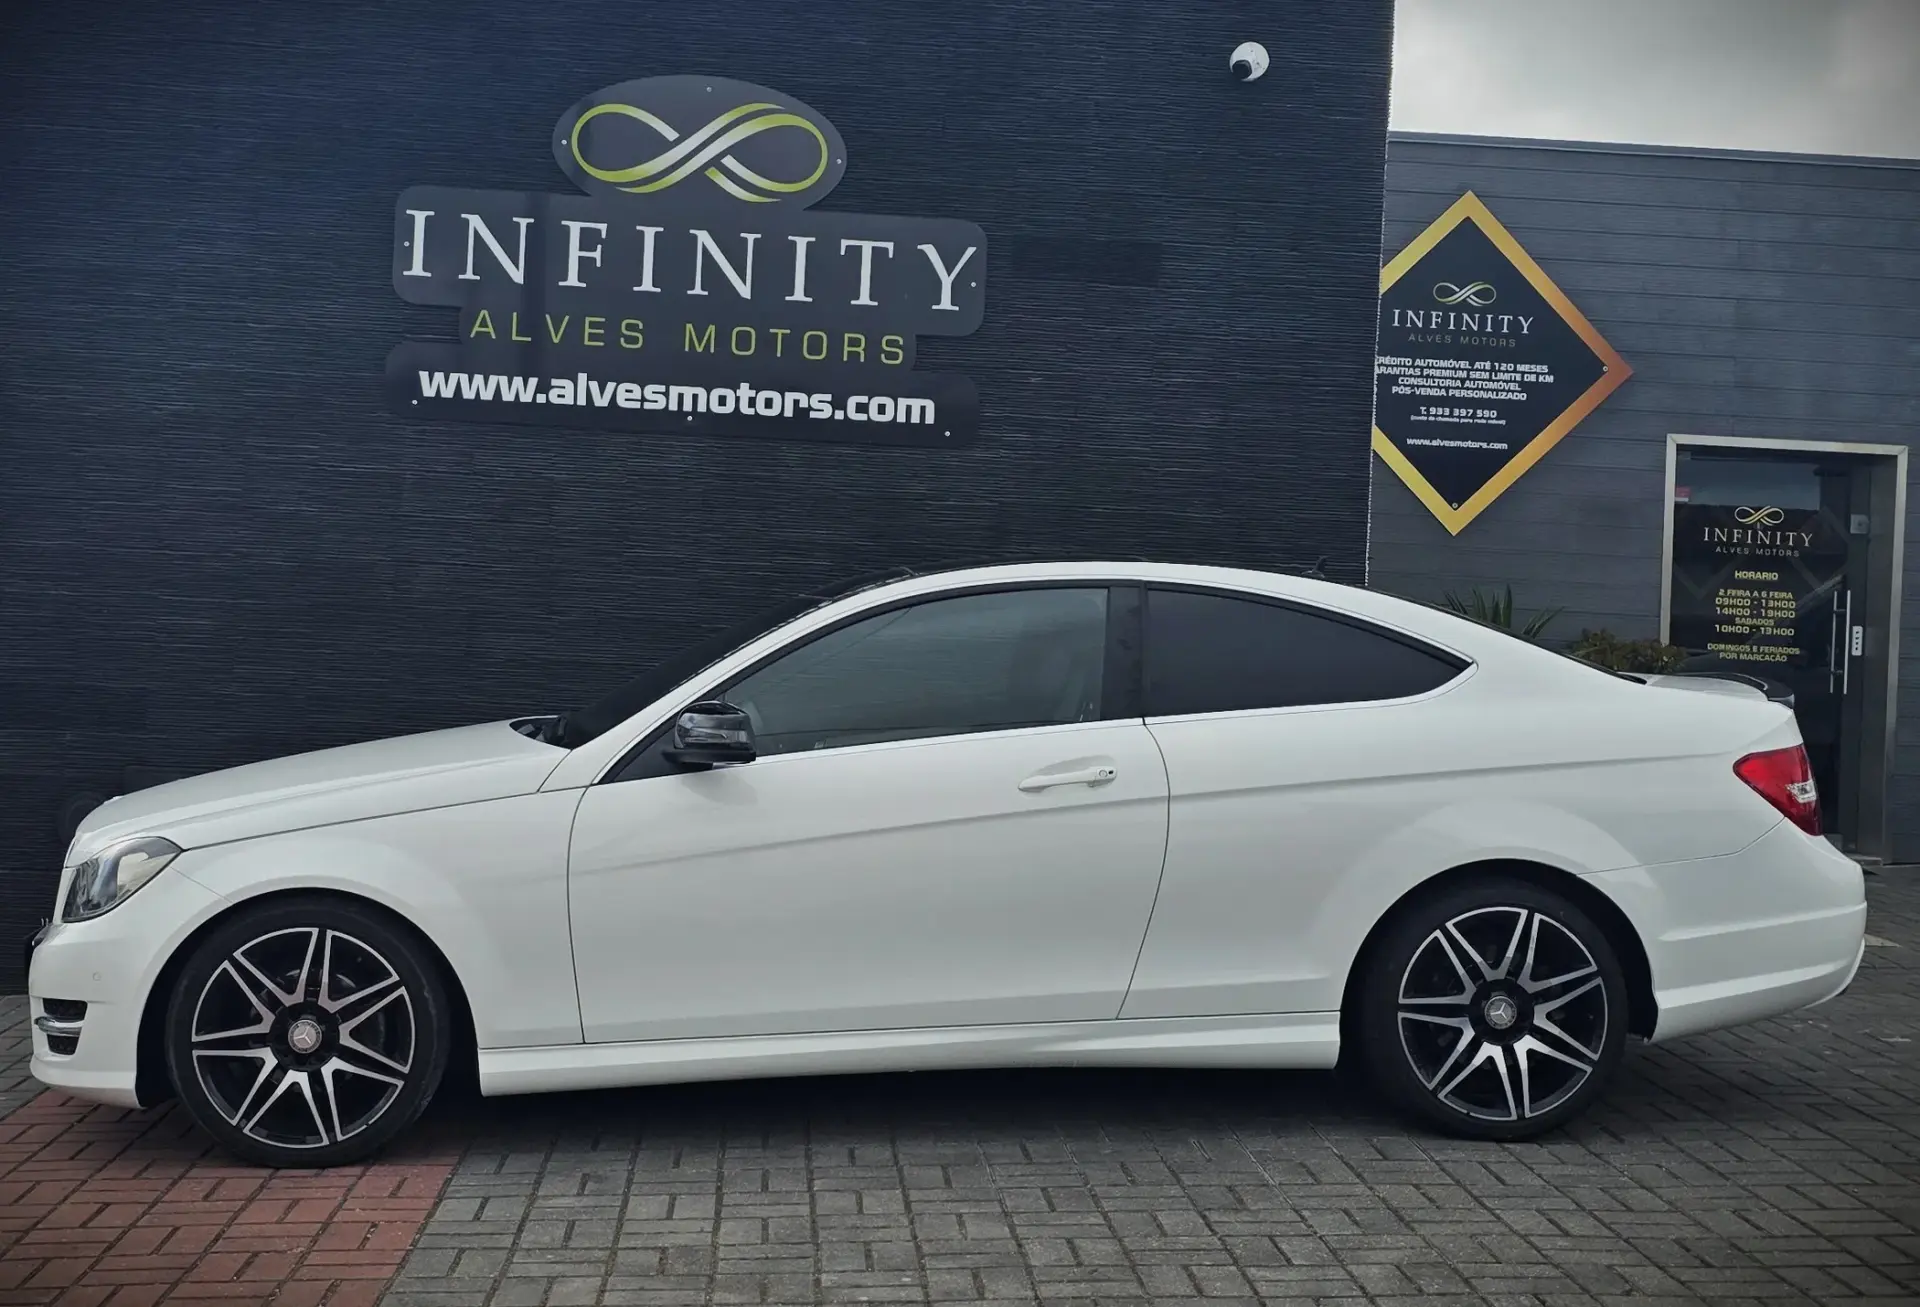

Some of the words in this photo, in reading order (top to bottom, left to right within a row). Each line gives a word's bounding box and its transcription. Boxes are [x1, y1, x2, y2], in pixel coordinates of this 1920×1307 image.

[402, 209, 977, 311] INFINITY
[1392, 309, 1534, 334] INFINITY
[470, 309, 644, 348] ALVES
[684, 323, 904, 364] MOTORS
[1408, 333, 1452, 344] ALVES
[1460, 336, 1516, 347] MOTORS
[1414, 358, 1471, 369] AUTOMÓVEL
[1473, 361, 1491, 370] ATÉ
[1494, 362, 1514, 371] 120
[1516, 364, 1549, 373] MESES
[1375, 366, 1421, 376] ARANTIAS
[1423, 368, 1467, 379] PREMIUM
[1469, 371, 1490, 380] SEM
[1492, 372, 1522, 382] LIMITE
[1524, 374, 1537, 382] DE
[1538, 375, 1554, 383] KM
[1398, 377, 1462, 388] CONSULTORIA
[1464, 380, 1522, 391] AUTOMÓVEL
[418, 370, 935, 424] www.alvesmotors.com
[1392, 385, 1447, 396] PÓS-VENDA
[1448, 389, 1527, 401] PERSONALIZADO
[1429, 406, 1450, 416] 933
[1453, 408, 1474, 417] 397
[1476, 409, 1497, 418] 590
[1406, 438, 1508, 450] www.alvesmotors.com
[1703, 527, 1813, 547] INFINITY
[1715, 546, 1749, 555] ALVES
[1756, 549, 1800, 557] MOTORS
[1734, 570, 1779, 581] HORARIO
[1715, 597, 1751, 606] 09H00
[1761, 599, 1796, 609] 13H00
[1715, 607, 1751, 616] 14H00
[1714, 625, 1750, 634] 10H00
[1760, 627, 1795, 636] 13H00
[1707, 643, 1751, 652] DOMINGOS
[1759, 646, 1801, 655] FERIADOS
[1719, 652, 1738, 660] POR
